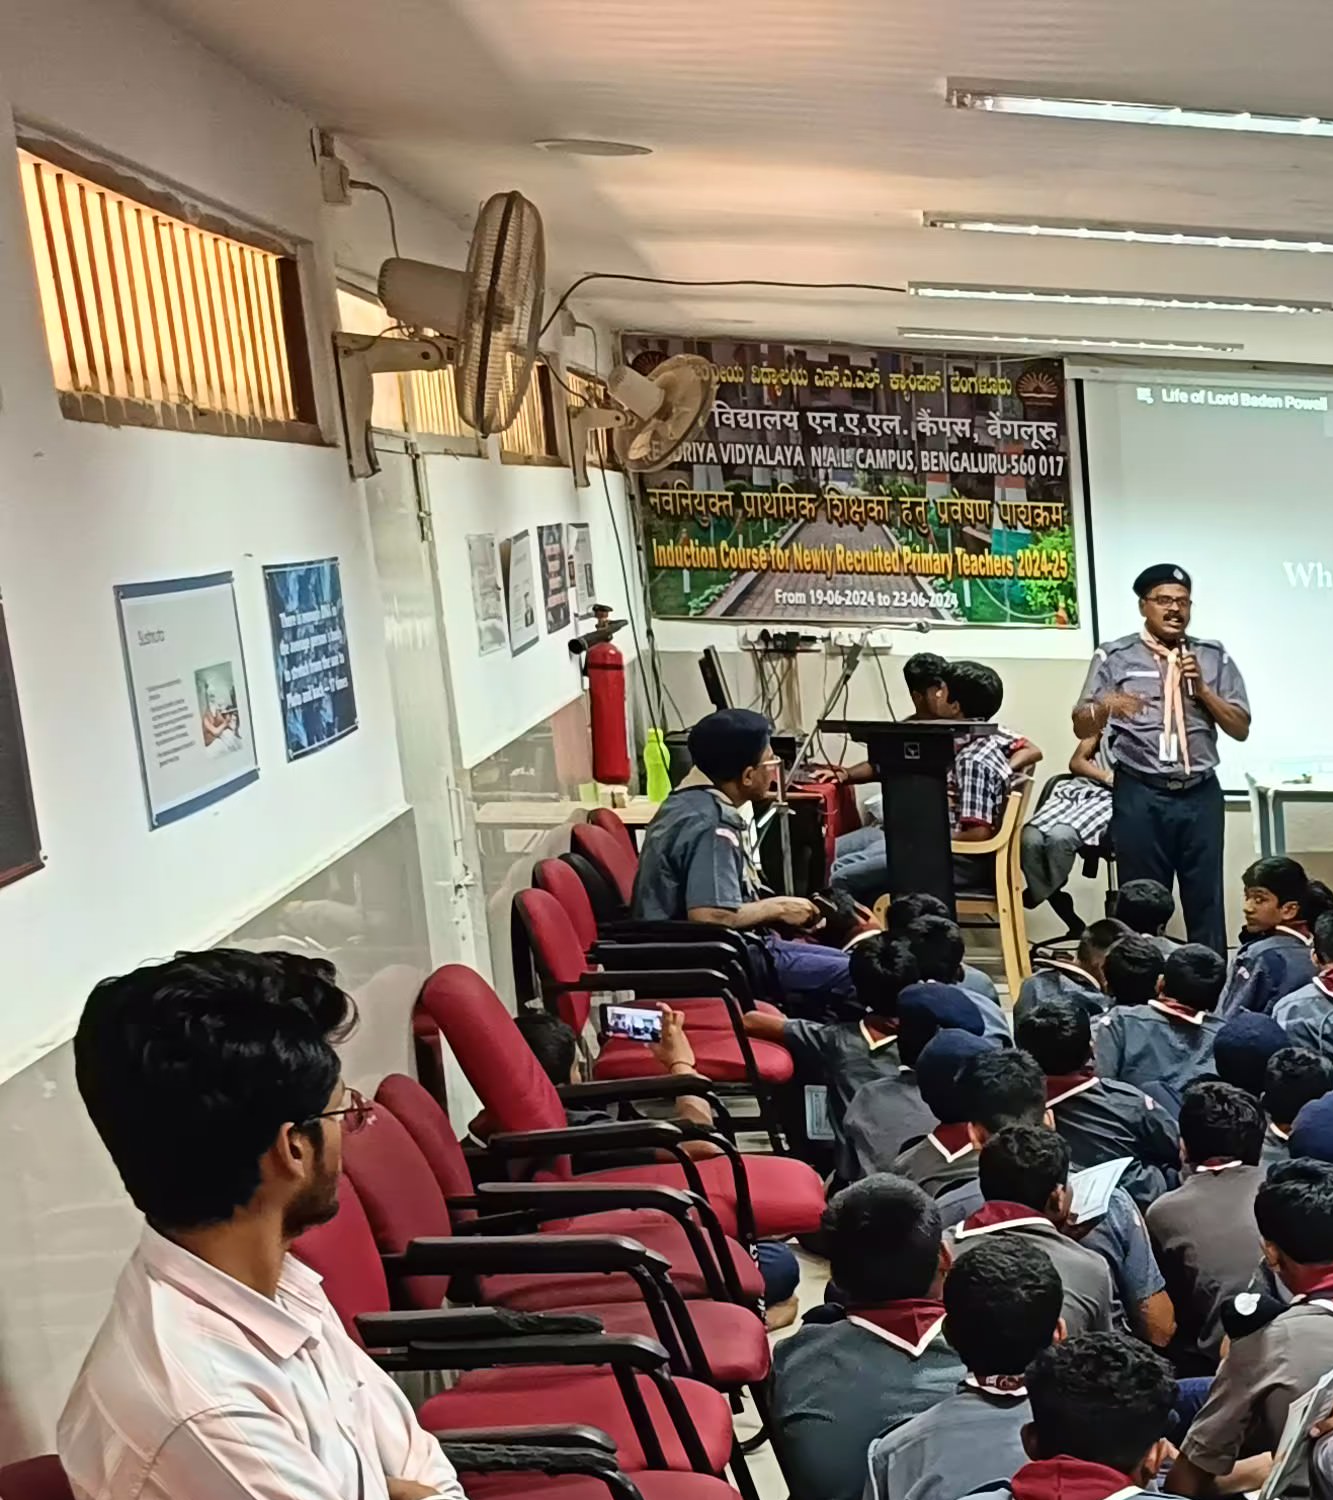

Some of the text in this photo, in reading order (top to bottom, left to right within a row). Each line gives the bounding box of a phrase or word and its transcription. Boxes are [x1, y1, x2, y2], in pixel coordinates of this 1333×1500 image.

[1161, 388, 1188, 404] Life
[1190, 390, 1204, 404] of
[1207, 391, 1238, 407] Lord
[710, 400, 799, 432] विद्यालय
[720, 442, 805, 467] VIDYALAYA
[856, 448, 917, 475] CAMPUS,
[1038, 455, 1064, 477] 017
[646, 479, 734, 528] नवनियुक्त
[741, 482, 817, 520] प्राथमिक
[824, 483, 892, 531] शिक्षकों
[899, 485, 929, 535] हेतु
[652, 537, 1068, 581] Induction Course for Newly Recruited Primary Teachers 2024-25
[774, 588, 959, 609] From 19-06-2024 to 23-06-2024
